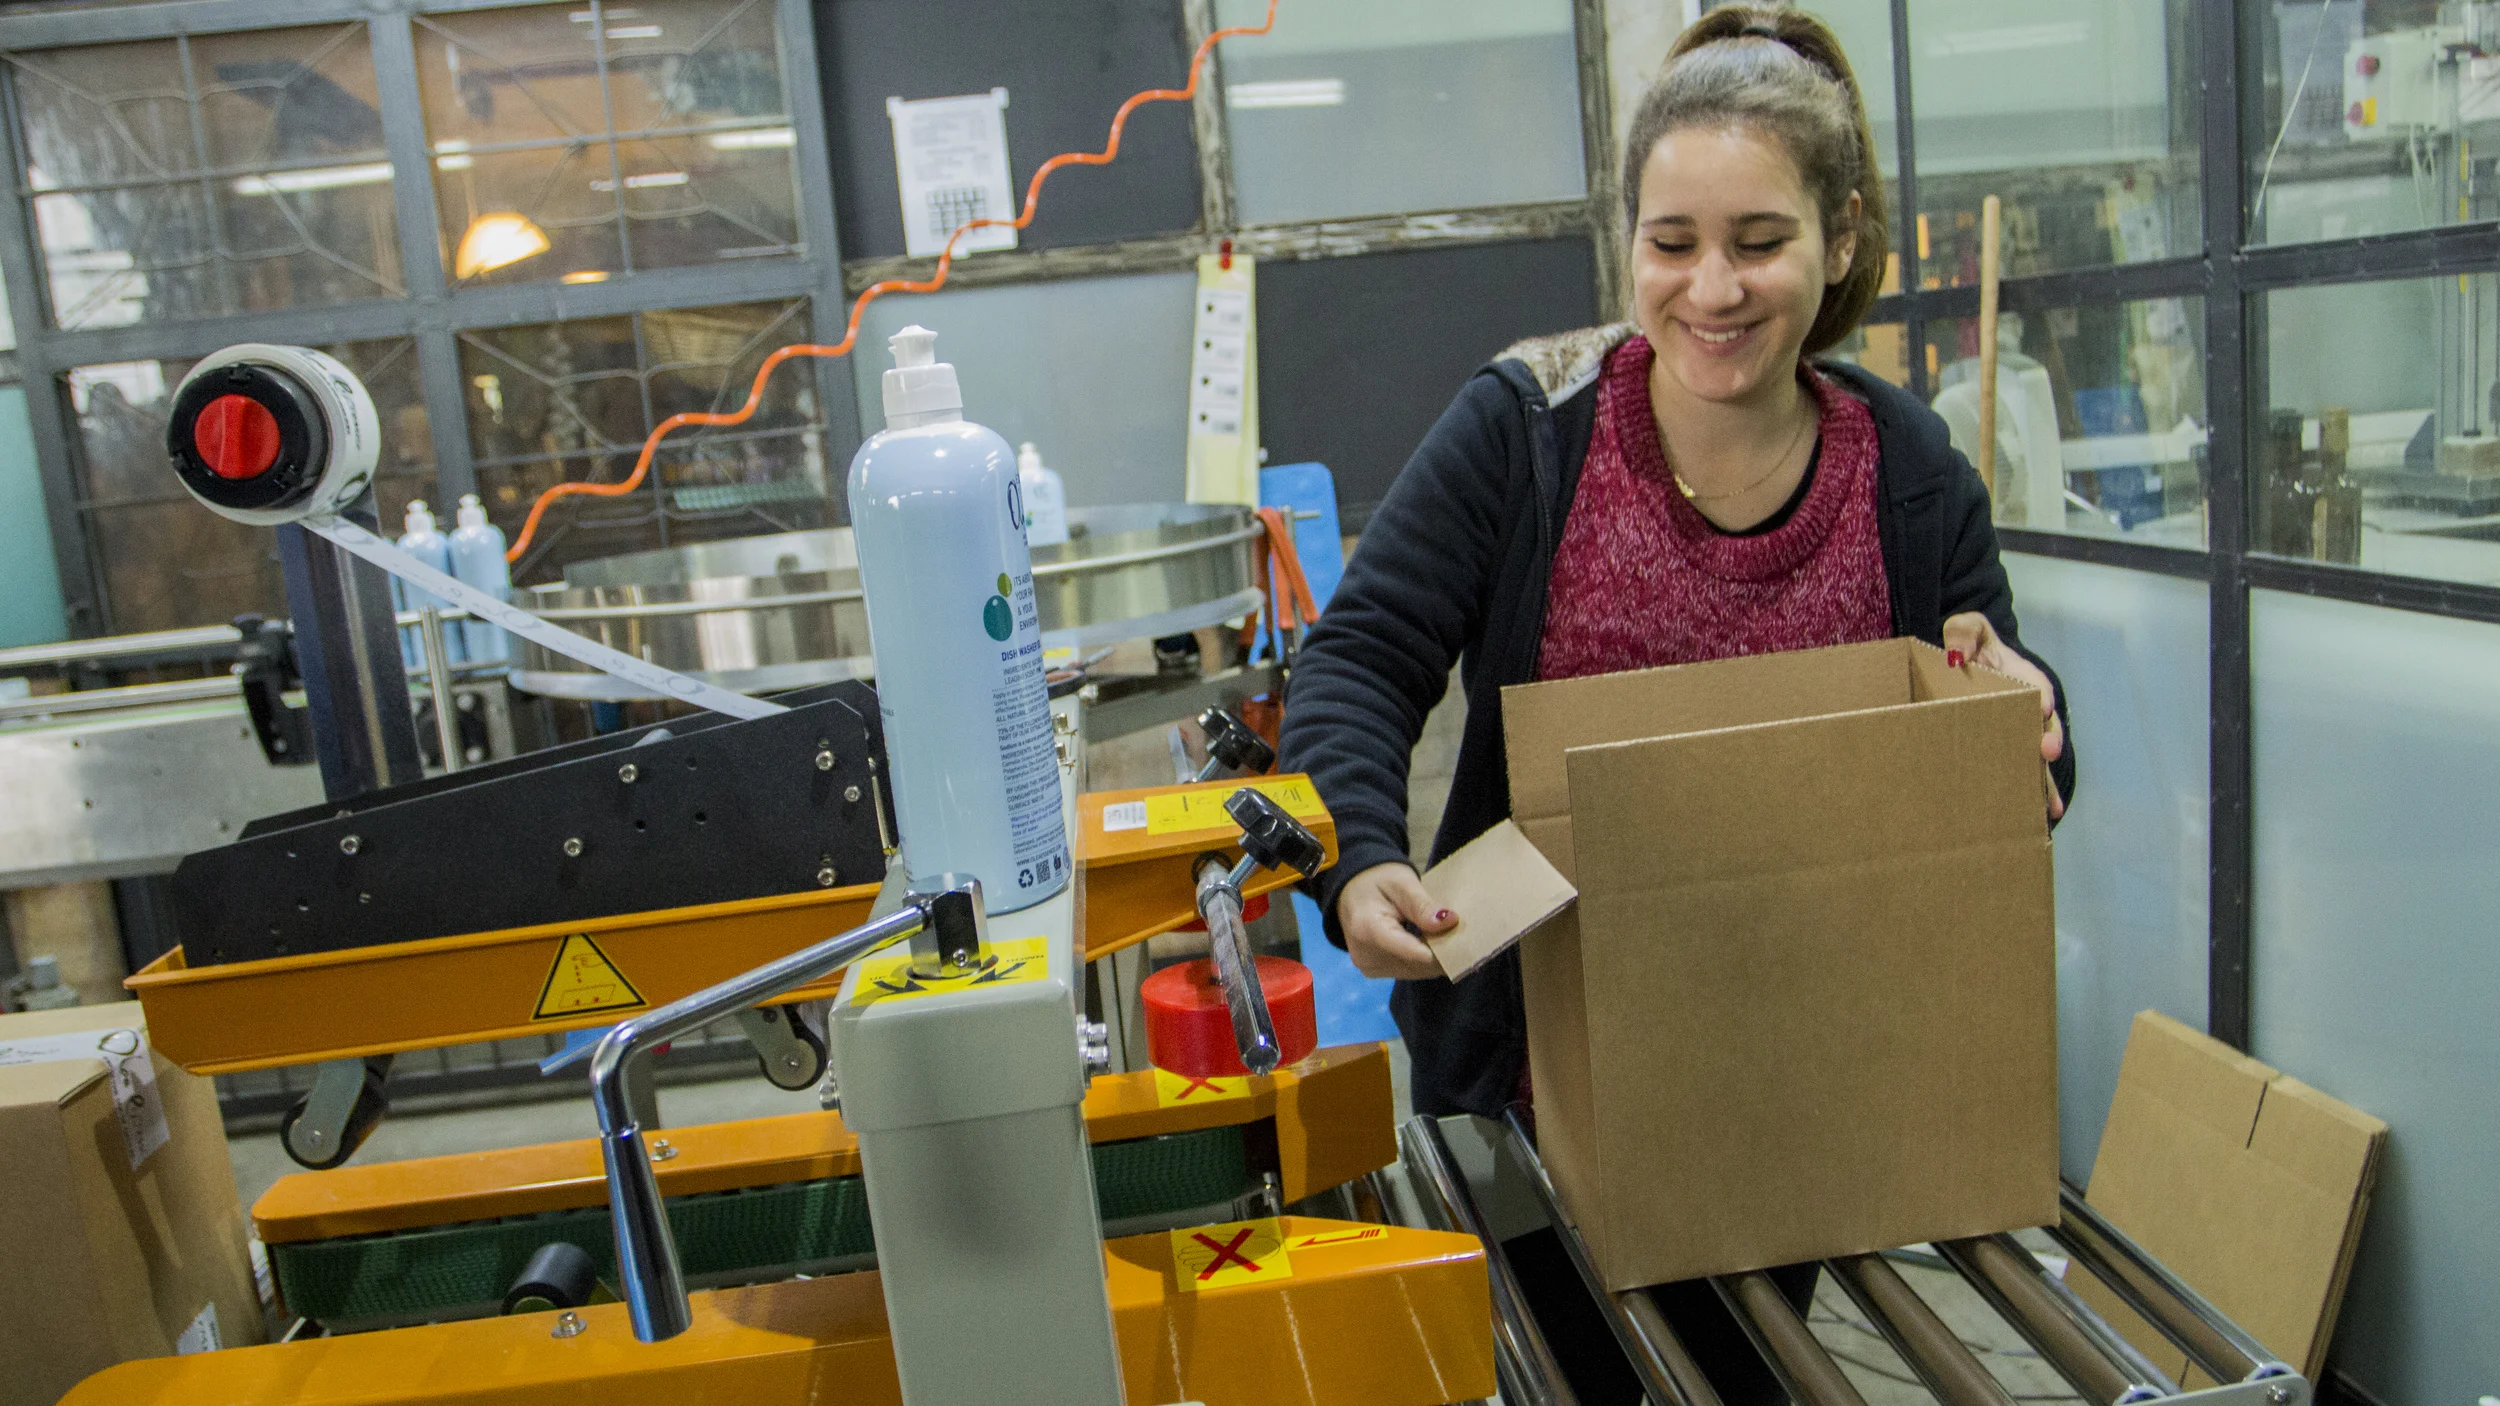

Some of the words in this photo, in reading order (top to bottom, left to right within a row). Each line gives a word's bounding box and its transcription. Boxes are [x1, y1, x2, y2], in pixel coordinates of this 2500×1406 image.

[1014, 590, 1028, 601] YOUR
[1002, 650, 1018, 661] DISH
[1014, 782, 1029, 793] USING
[1008, 800, 1032, 812] SURFACE
